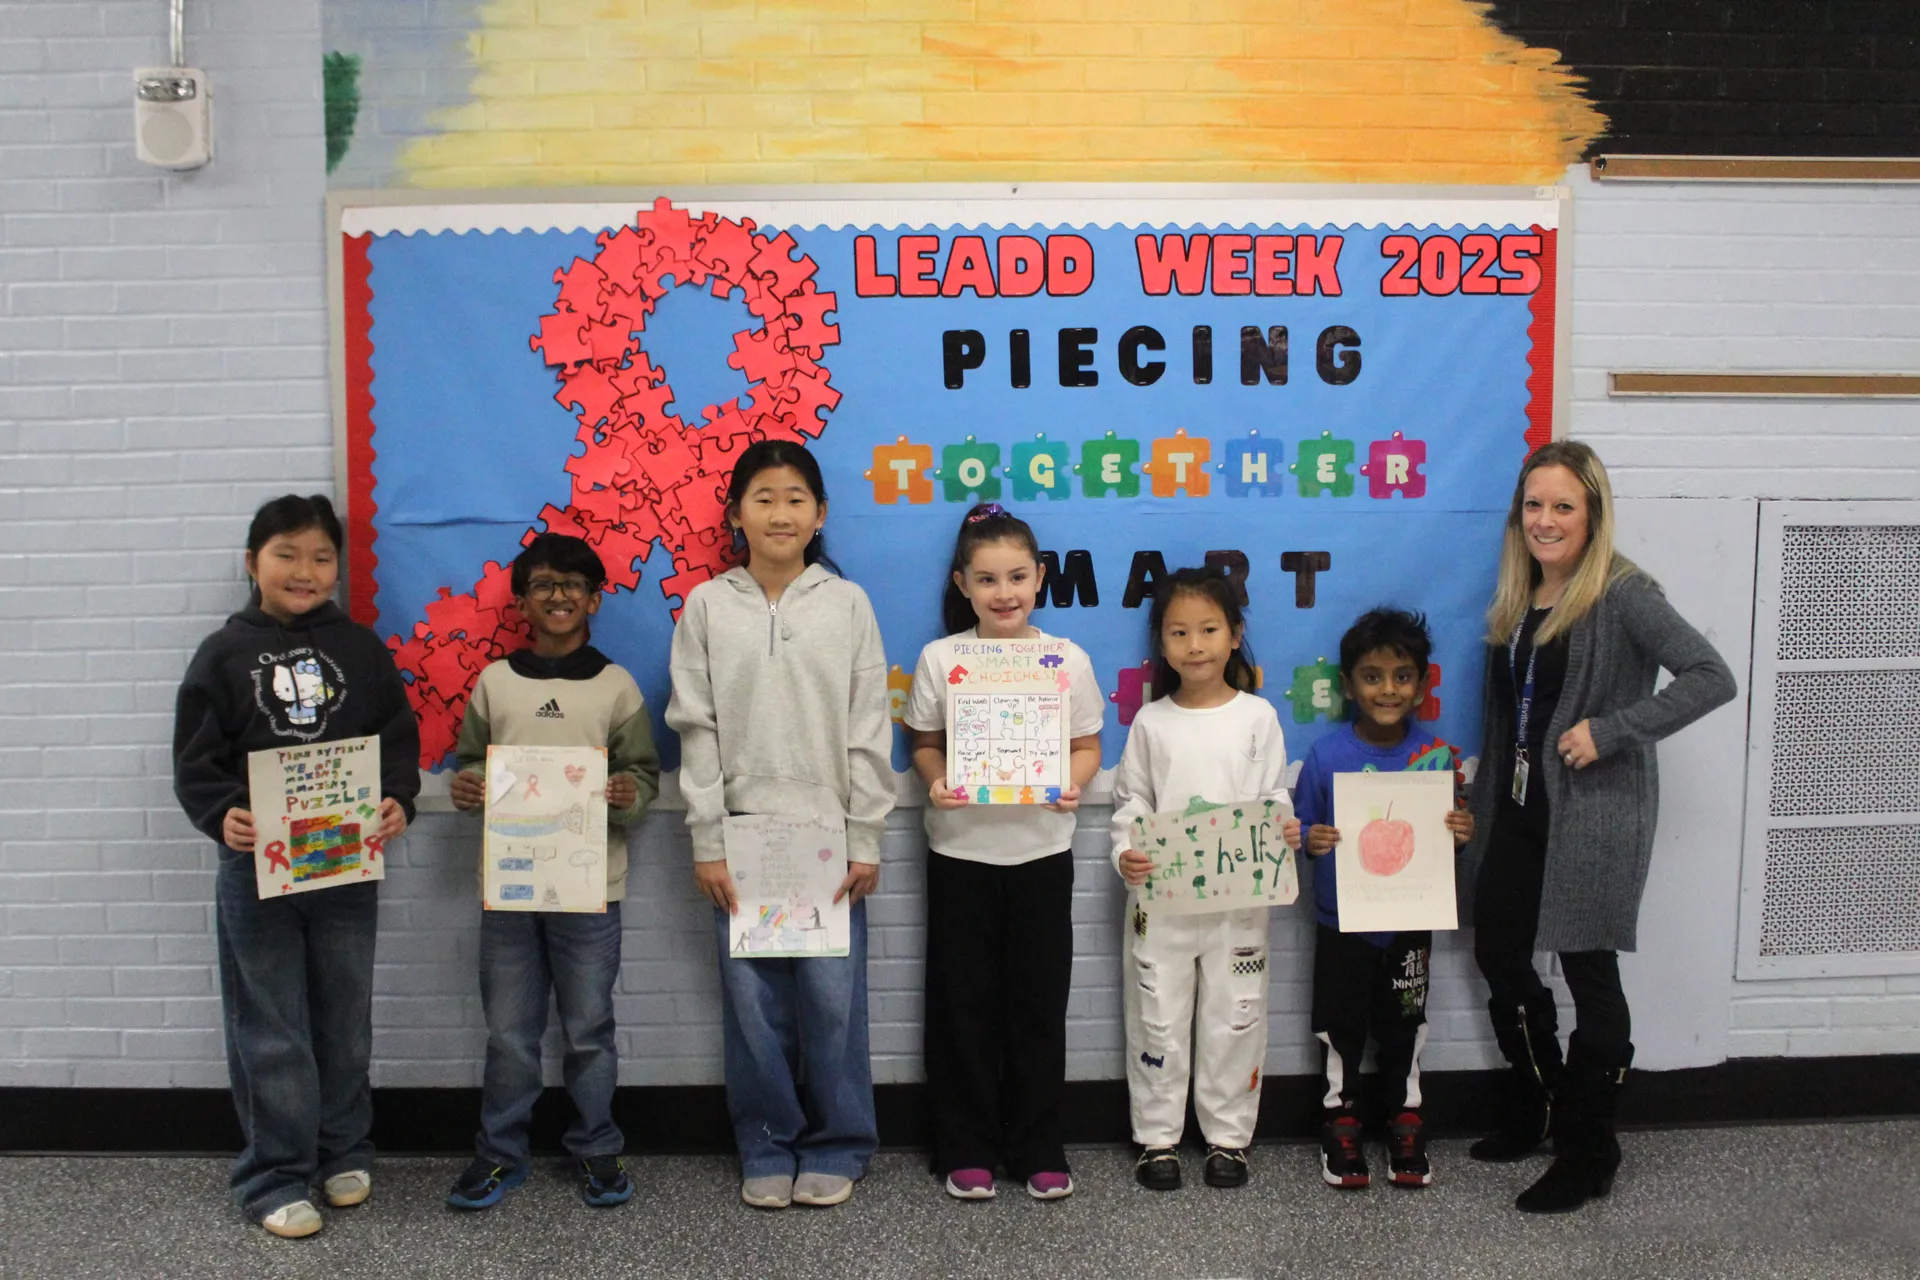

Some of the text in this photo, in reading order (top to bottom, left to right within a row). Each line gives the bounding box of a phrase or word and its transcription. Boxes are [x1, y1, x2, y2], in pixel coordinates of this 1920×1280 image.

[854, 234, 1542, 297] LEADD WEEK 2025
[942, 325, 1362, 389] PIECING
[889, 453, 1409, 489] TOGETHER
[1035, 549, 1331, 609] MART
[954, 642, 1065, 655] PIECING TOGETHER
[975, 655, 1033, 670] SMART
[535, 709, 565, 719] adidas
[957, 697, 971, 705] Kind
[1519, 698, 1532, 742] Levittown
[286, 787, 371, 814] PUZZLE
[1145, 850, 1188, 881] Eat
